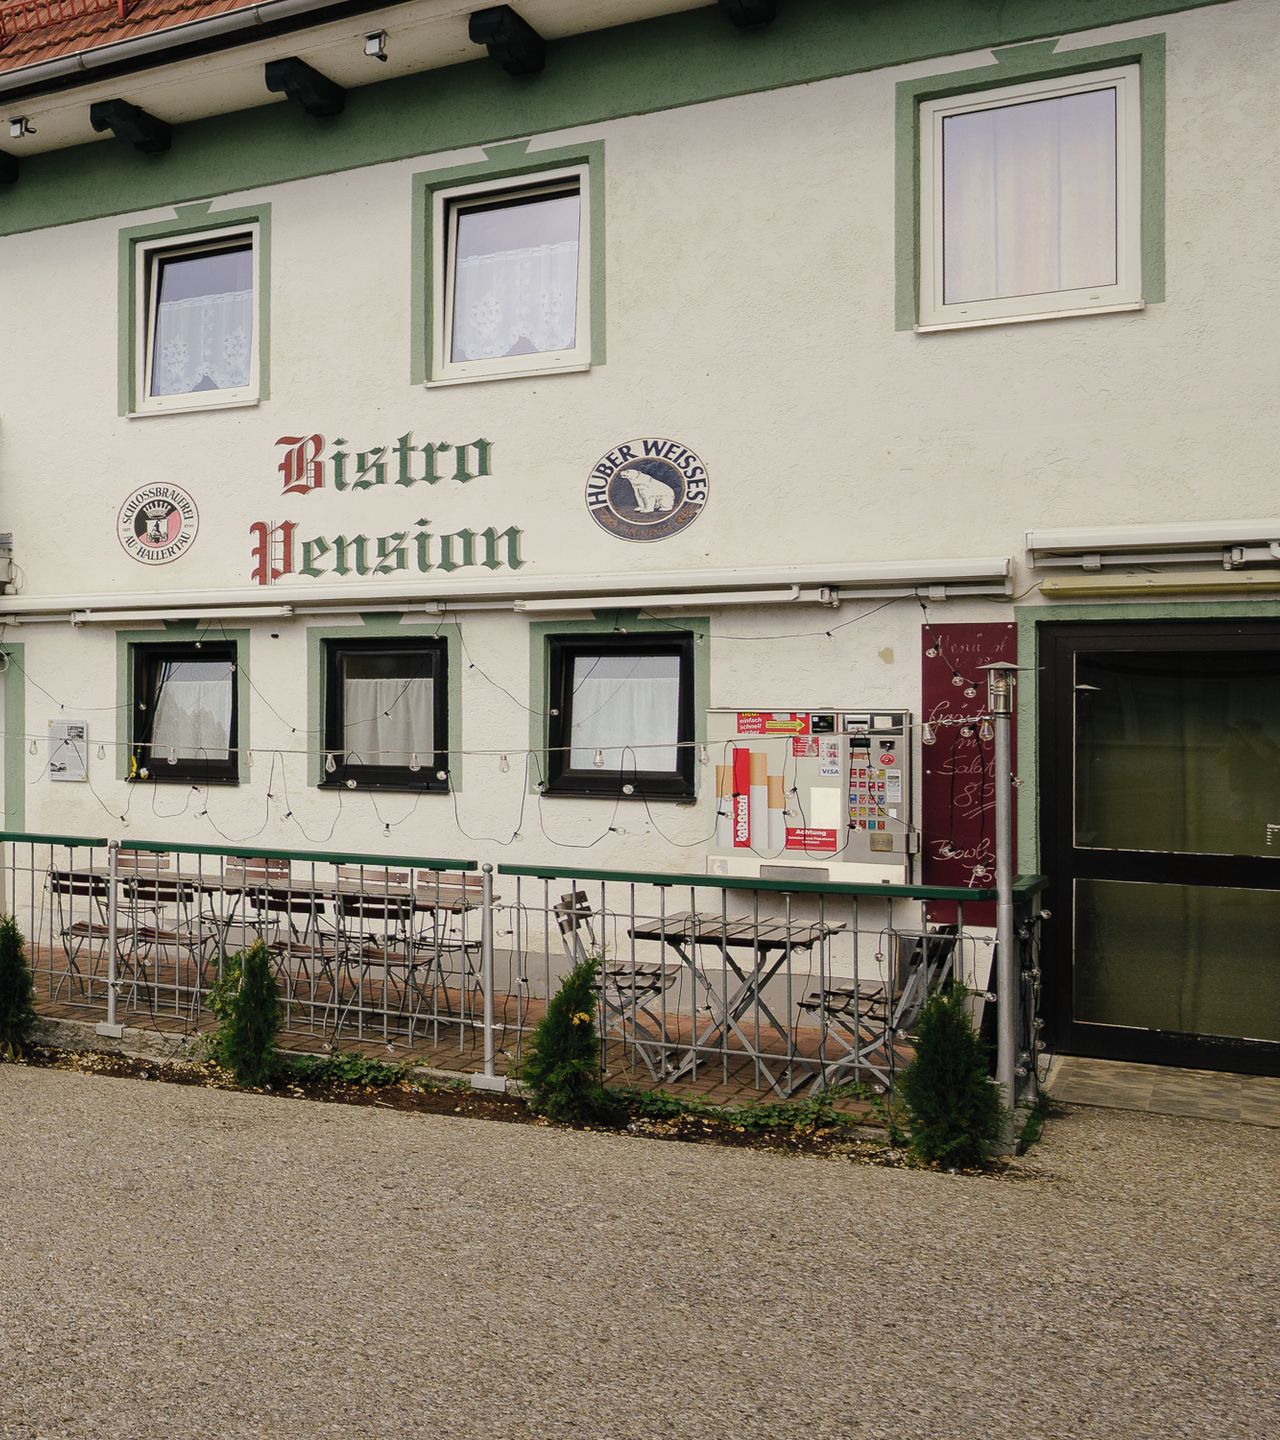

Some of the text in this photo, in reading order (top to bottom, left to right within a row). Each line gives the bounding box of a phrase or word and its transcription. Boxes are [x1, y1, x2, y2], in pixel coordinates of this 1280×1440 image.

[274, 430, 495, 496] Bistro
[587, 440, 707, 507] HUBER WEISSES
[122, 486, 195, 525] SCHLOSSBRAUEREI
[249, 517, 526, 587] Pension
[739, 716, 762, 724] einfach
[795, 828, 827, 837] Achtung
